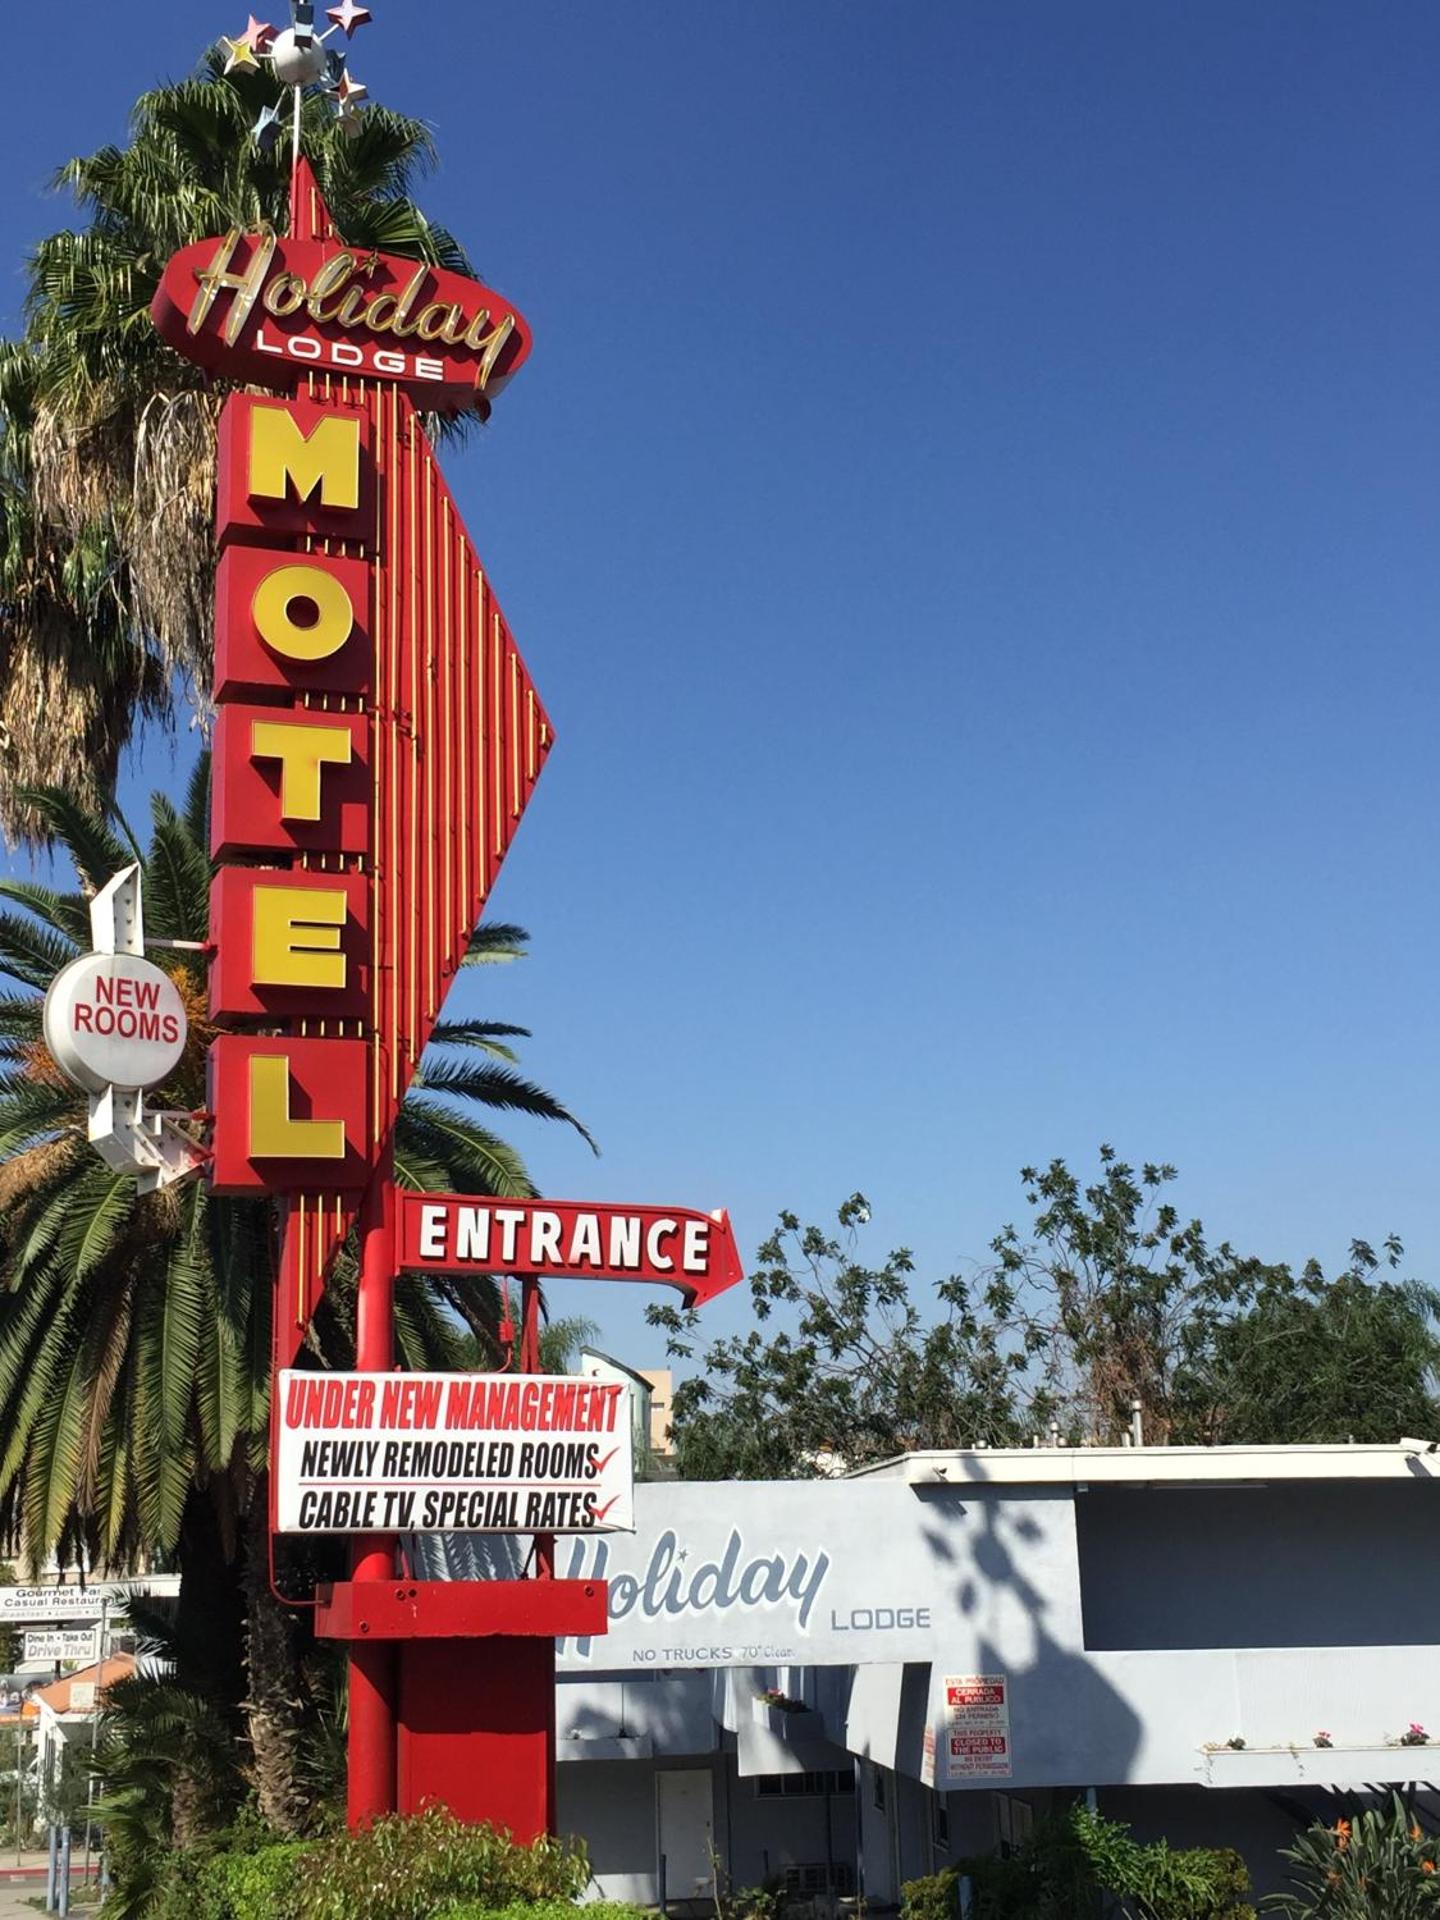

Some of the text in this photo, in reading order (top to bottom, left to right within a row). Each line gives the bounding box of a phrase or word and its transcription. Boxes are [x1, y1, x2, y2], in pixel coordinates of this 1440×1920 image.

[188, 222, 515, 391] Holiday
[257, 329, 444, 381] LODGE
[248, 404, 361, 1160] MOTEL
[96, 975, 160, 1010] NEW
[74, 1003, 179, 1044] ROOMS
[420, 1204, 709, 1271] ENTRANCE
[285, 1379, 624, 1433] UNDER NEW MANAGEMENT
[300, 1441, 600, 1480] NEWLY REMODELED ROOMS
[299, 1491, 597, 1532] CABLE TV, SPECIAL RATES
[4, 1596, 115, 1607] Casual Restaur
[16, 1588, 74, 1598] Gourmet
[27, 1632, 93, 1643] Dine In Take Out
[831, 1608, 931, 1632] LODGE
[28, 1644, 92, 1657] Drive Thru
[633, 1649, 656, 1661] NO
[662, 1646, 732, 1660] TRUCKS
[954, 1738, 988, 1747] CLOSED
